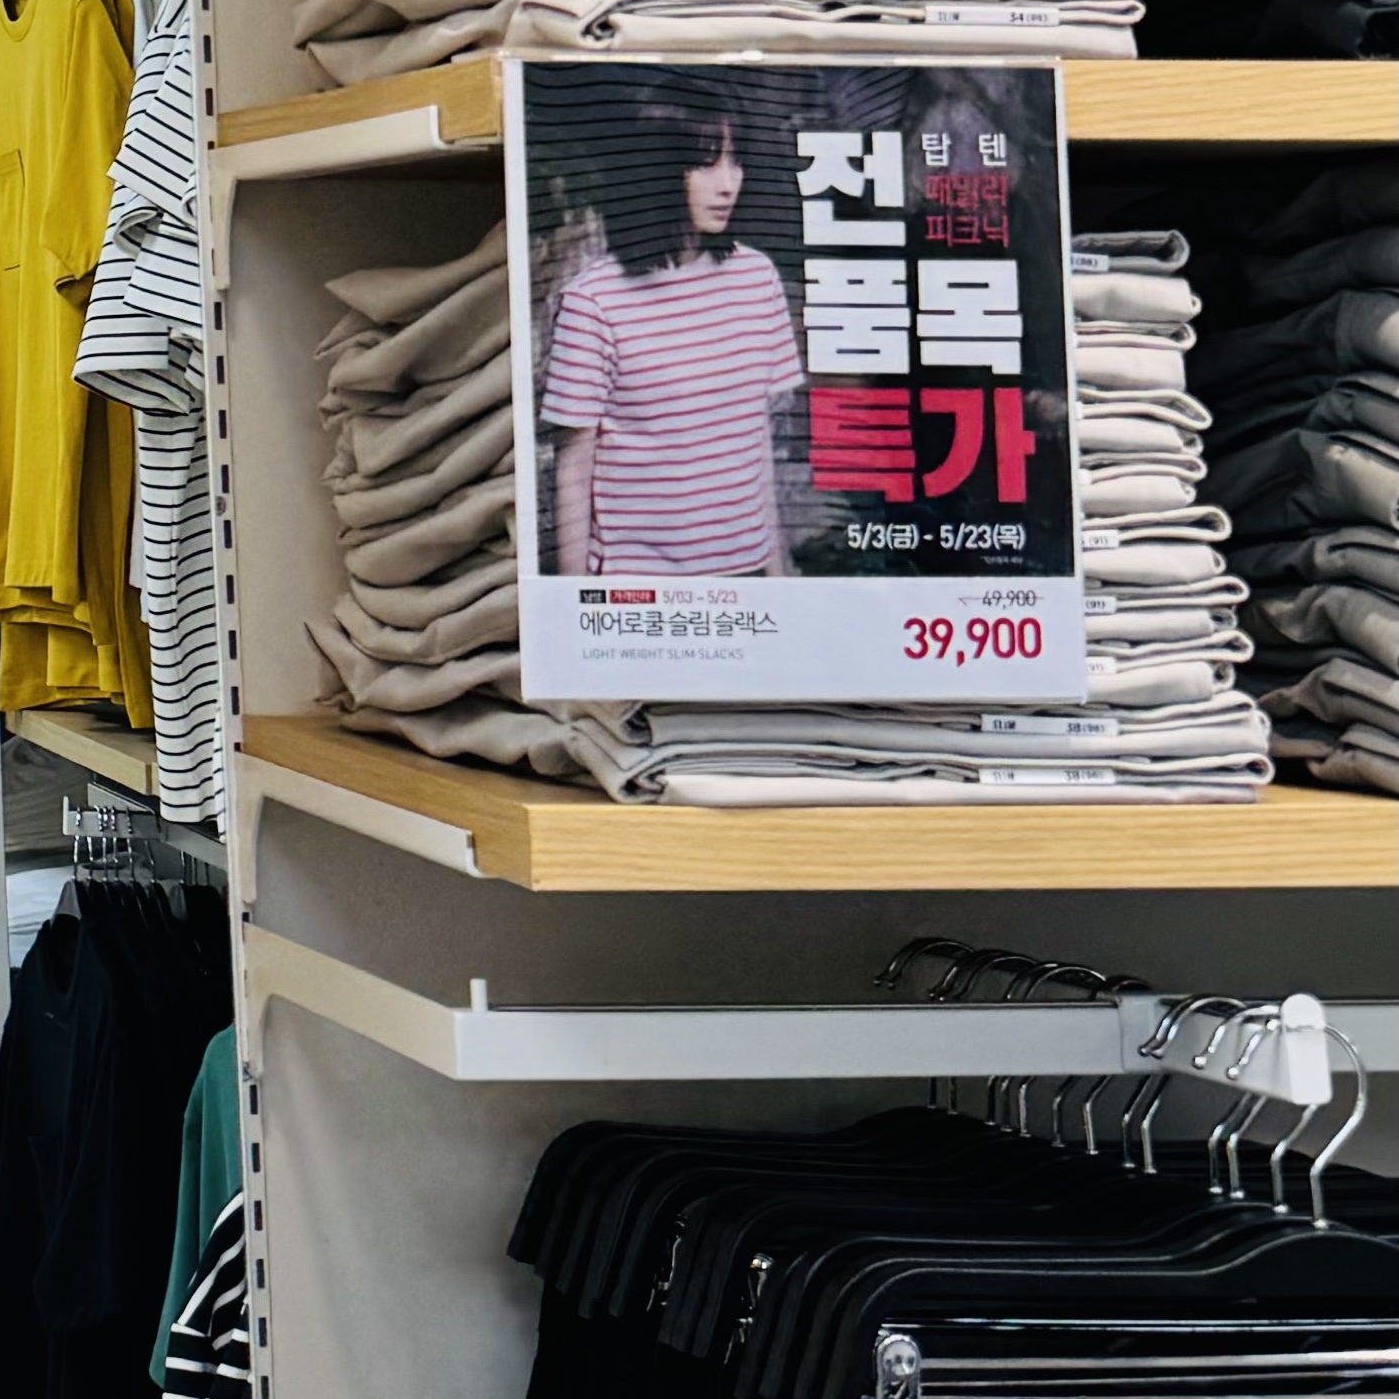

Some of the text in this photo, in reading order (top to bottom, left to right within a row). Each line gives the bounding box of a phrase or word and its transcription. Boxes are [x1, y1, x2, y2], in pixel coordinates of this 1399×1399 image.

[921, 133, 1008, 167] 탑 텐
[796, 131, 906, 246] 전
[803, 258, 1024, 375] 품목
[807, 387, 1036, 503] 특가
[846, 522, 920, 551] 5/3(금)
[939, 522, 1026, 552] 5/23(목)
[662, 591, 693, 604] 5/03
[707, 591, 738, 604] 5/23
[981, 590, 1037, 610] 49,900
[579, 610, 779, 637] 에어로쿨 슬림 슬랙스
[582, 648, 745, 660] LIGHT WEIGHT SLIM SLACKS
[903, 617, 1042, 667] 39,900
